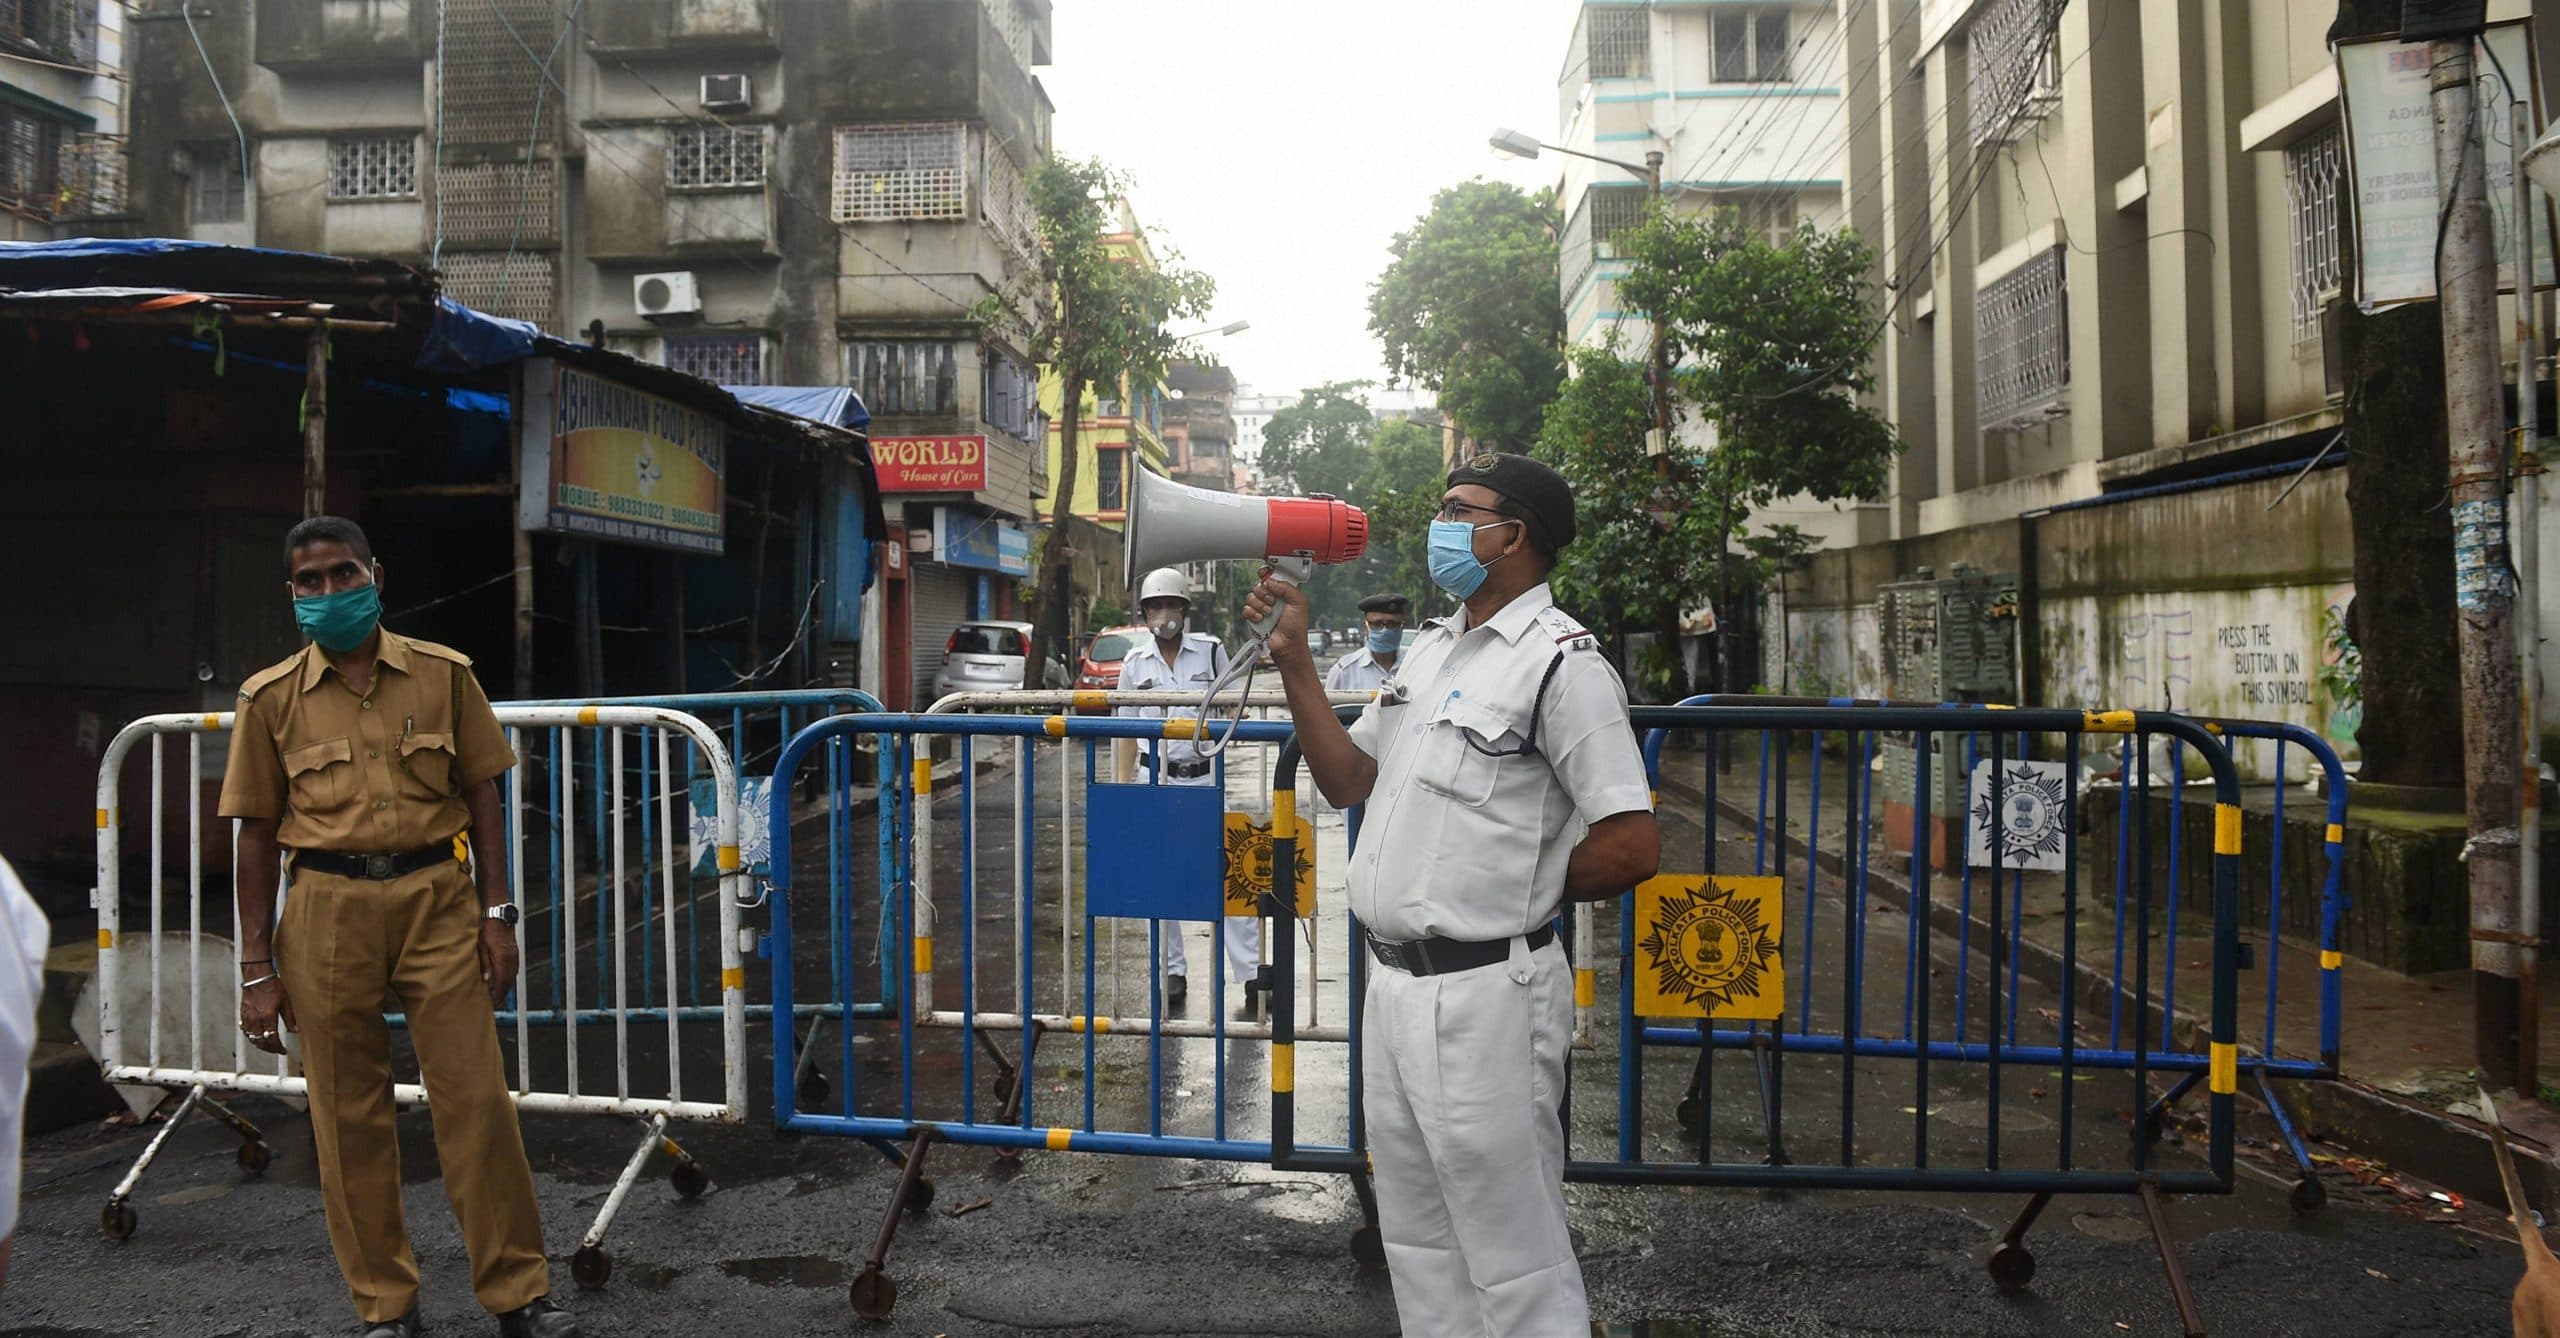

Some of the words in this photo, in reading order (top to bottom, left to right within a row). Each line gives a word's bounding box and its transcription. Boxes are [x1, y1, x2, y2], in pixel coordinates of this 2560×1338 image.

[559, 368, 649, 437] ABHINANDAN
[653, 400, 685, 446] FOOD
[871, 440, 980, 466] WORLD
[899, 468, 938, 482] House
[939, 468, 954, 486] of
[559, 485, 598, 509] MOBILE
[2218, 625, 2248, 648] PRESS
[2251, 624, 2271, 646] THE
[2235, 653, 2279, 674] BUTTON
[2284, 653, 2300, 674] ON
[2240, 682, 2265, 705] THIS
[2267, 680, 2313, 705] SYMBOL
[2019, 785, 2048, 802] POLICE
[2046, 803, 2055, 831] FORCE
[1235, 839, 1254, 879] KOLKATA
[1670, 912, 1697, 965] KOLKATA
[1702, 907, 1742, 929] POLICE
[1737, 931, 1750, 968] FORCE
